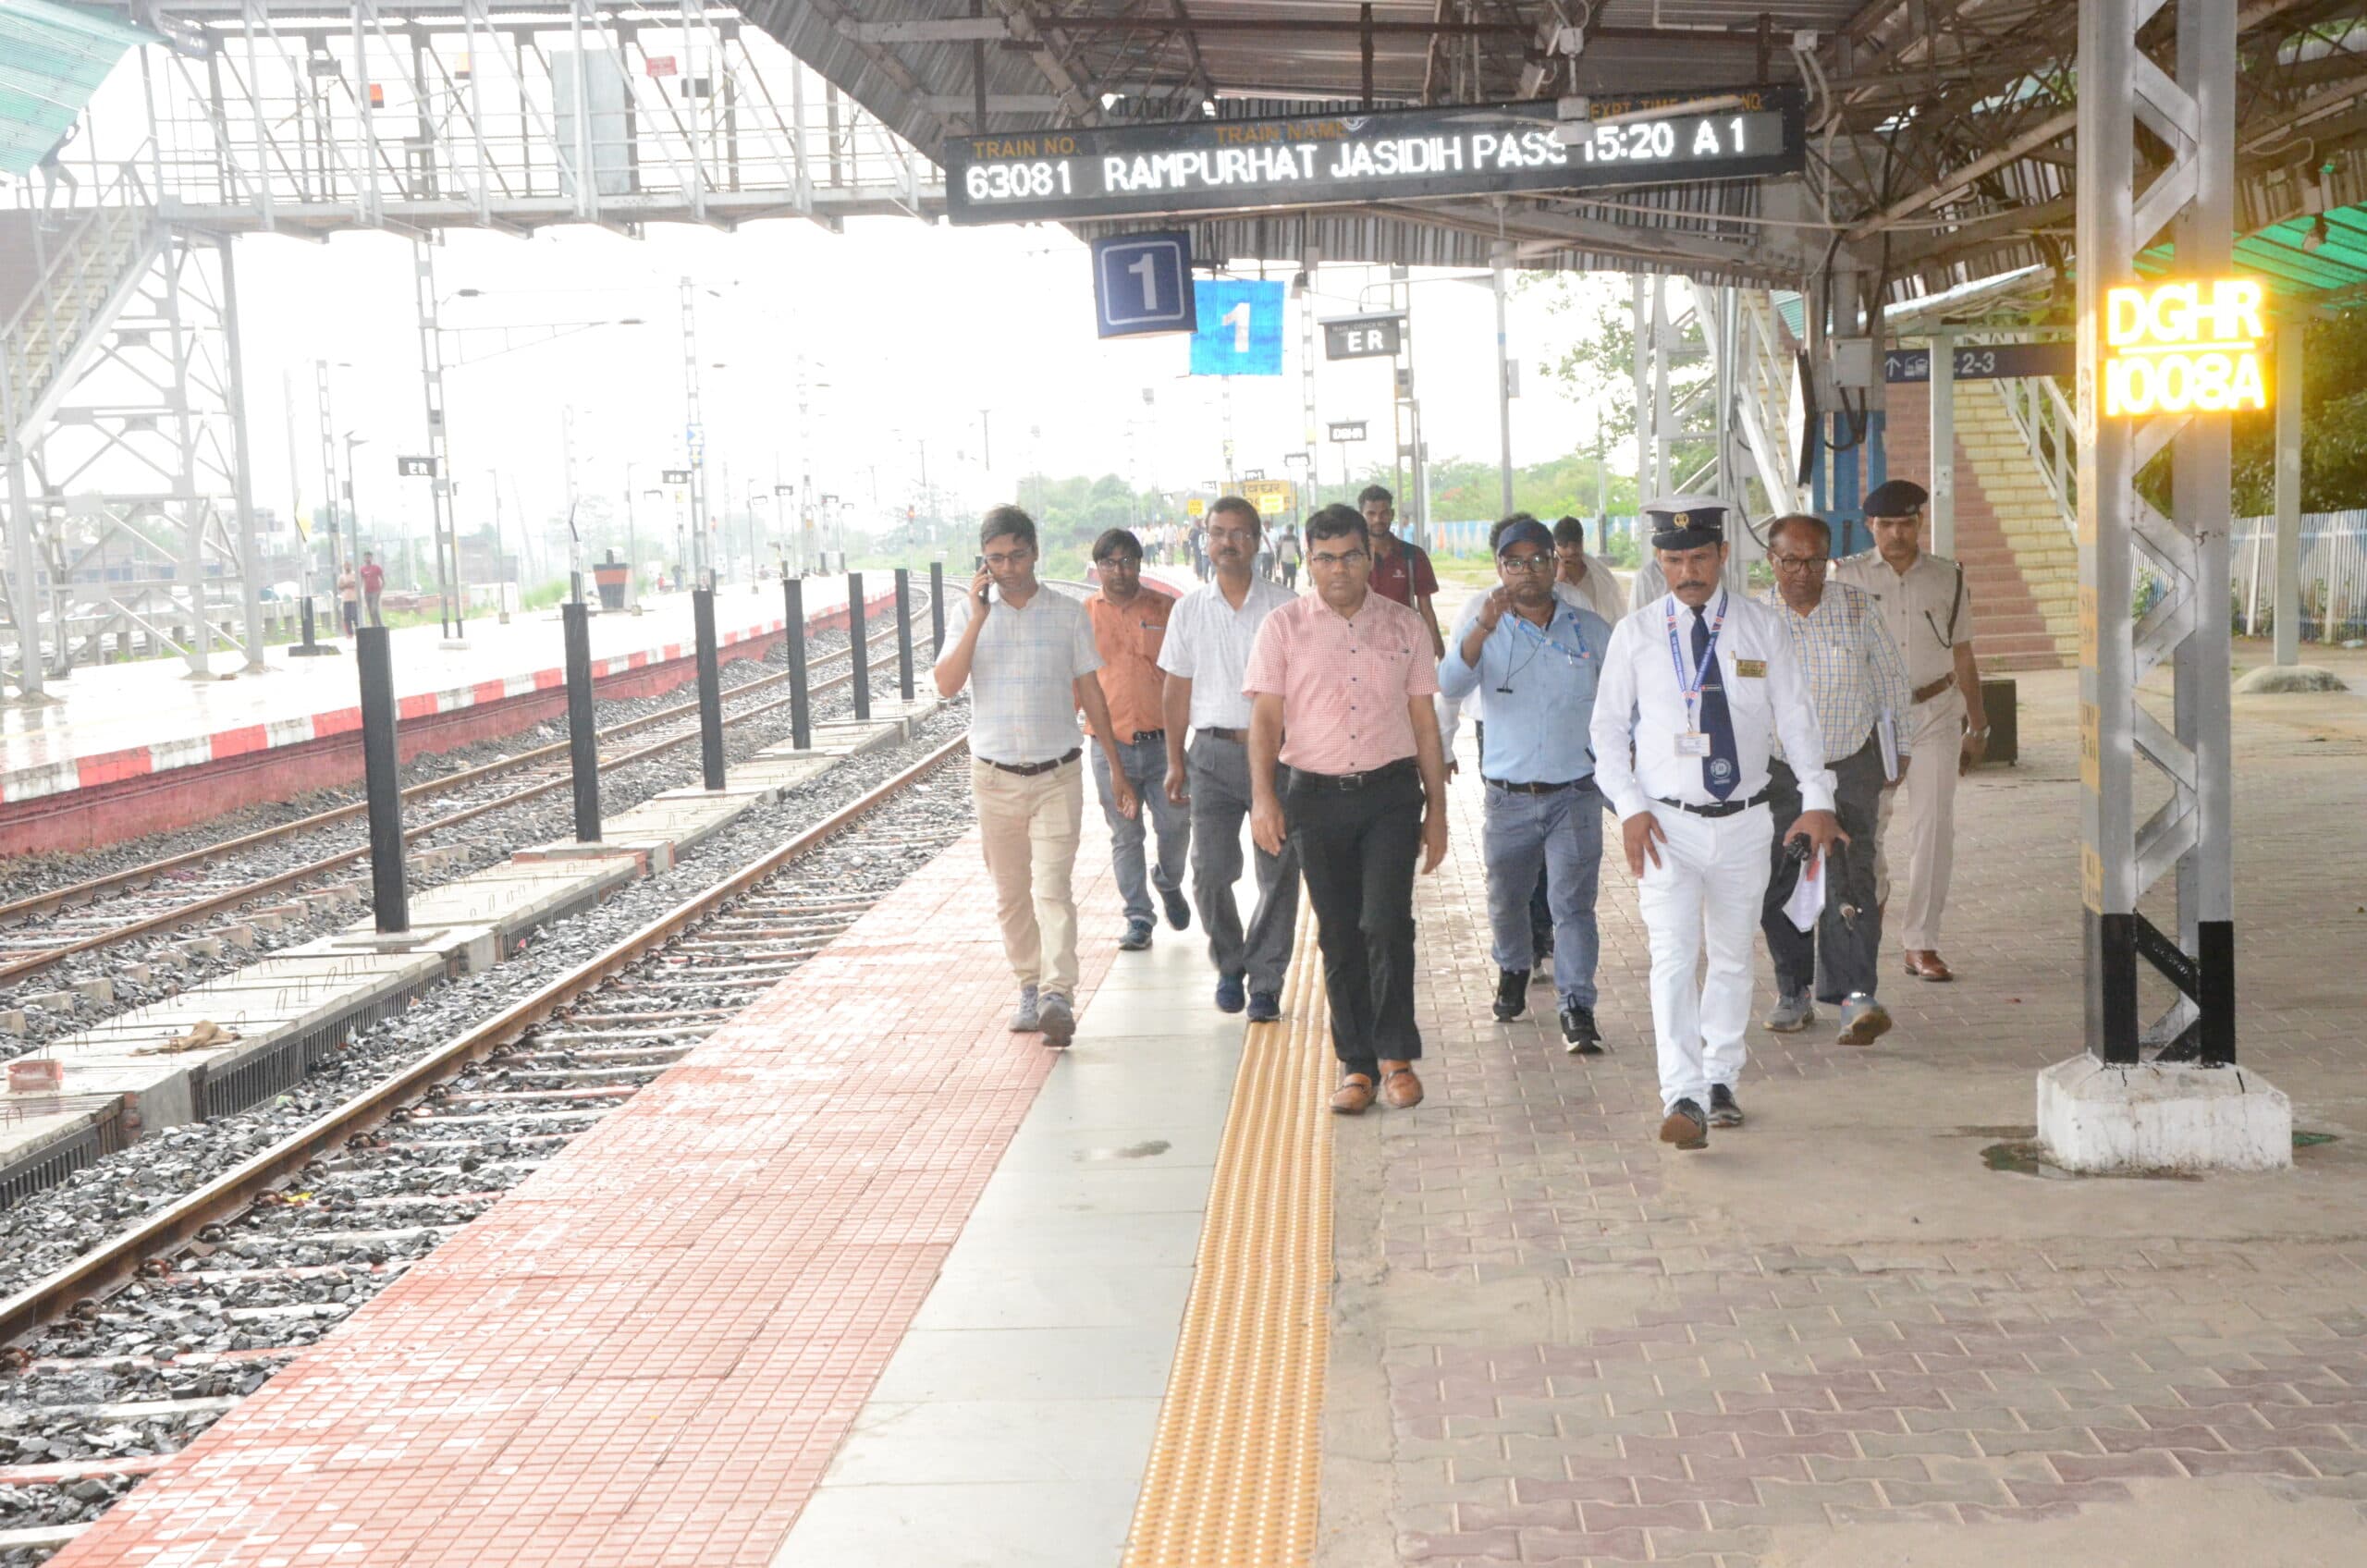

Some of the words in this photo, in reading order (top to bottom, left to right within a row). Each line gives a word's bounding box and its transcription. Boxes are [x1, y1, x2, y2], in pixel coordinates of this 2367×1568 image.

[966, 160, 1073, 200] 63081
[1103, 143, 1318, 192] RAMPURHAT
[1331, 135, 1464, 178] JASIDIH
[1472, 127, 1567, 169] PASS
[1693, 118, 1720, 155] A
[1730, 116, 1745, 153] 1
[974, 140, 1037, 159] TRAIN
[1214, 126, 1280, 144] TRAIN
[1287, 121, 1347, 140] NAME
[1128, 252, 1158, 311] 1
[1222, 302, 1251, 353] 1
[2107, 279, 2265, 346] DGHR
[1961, 351, 1995, 374] 2-3
[2105, 353, 2266, 416] 1008A
